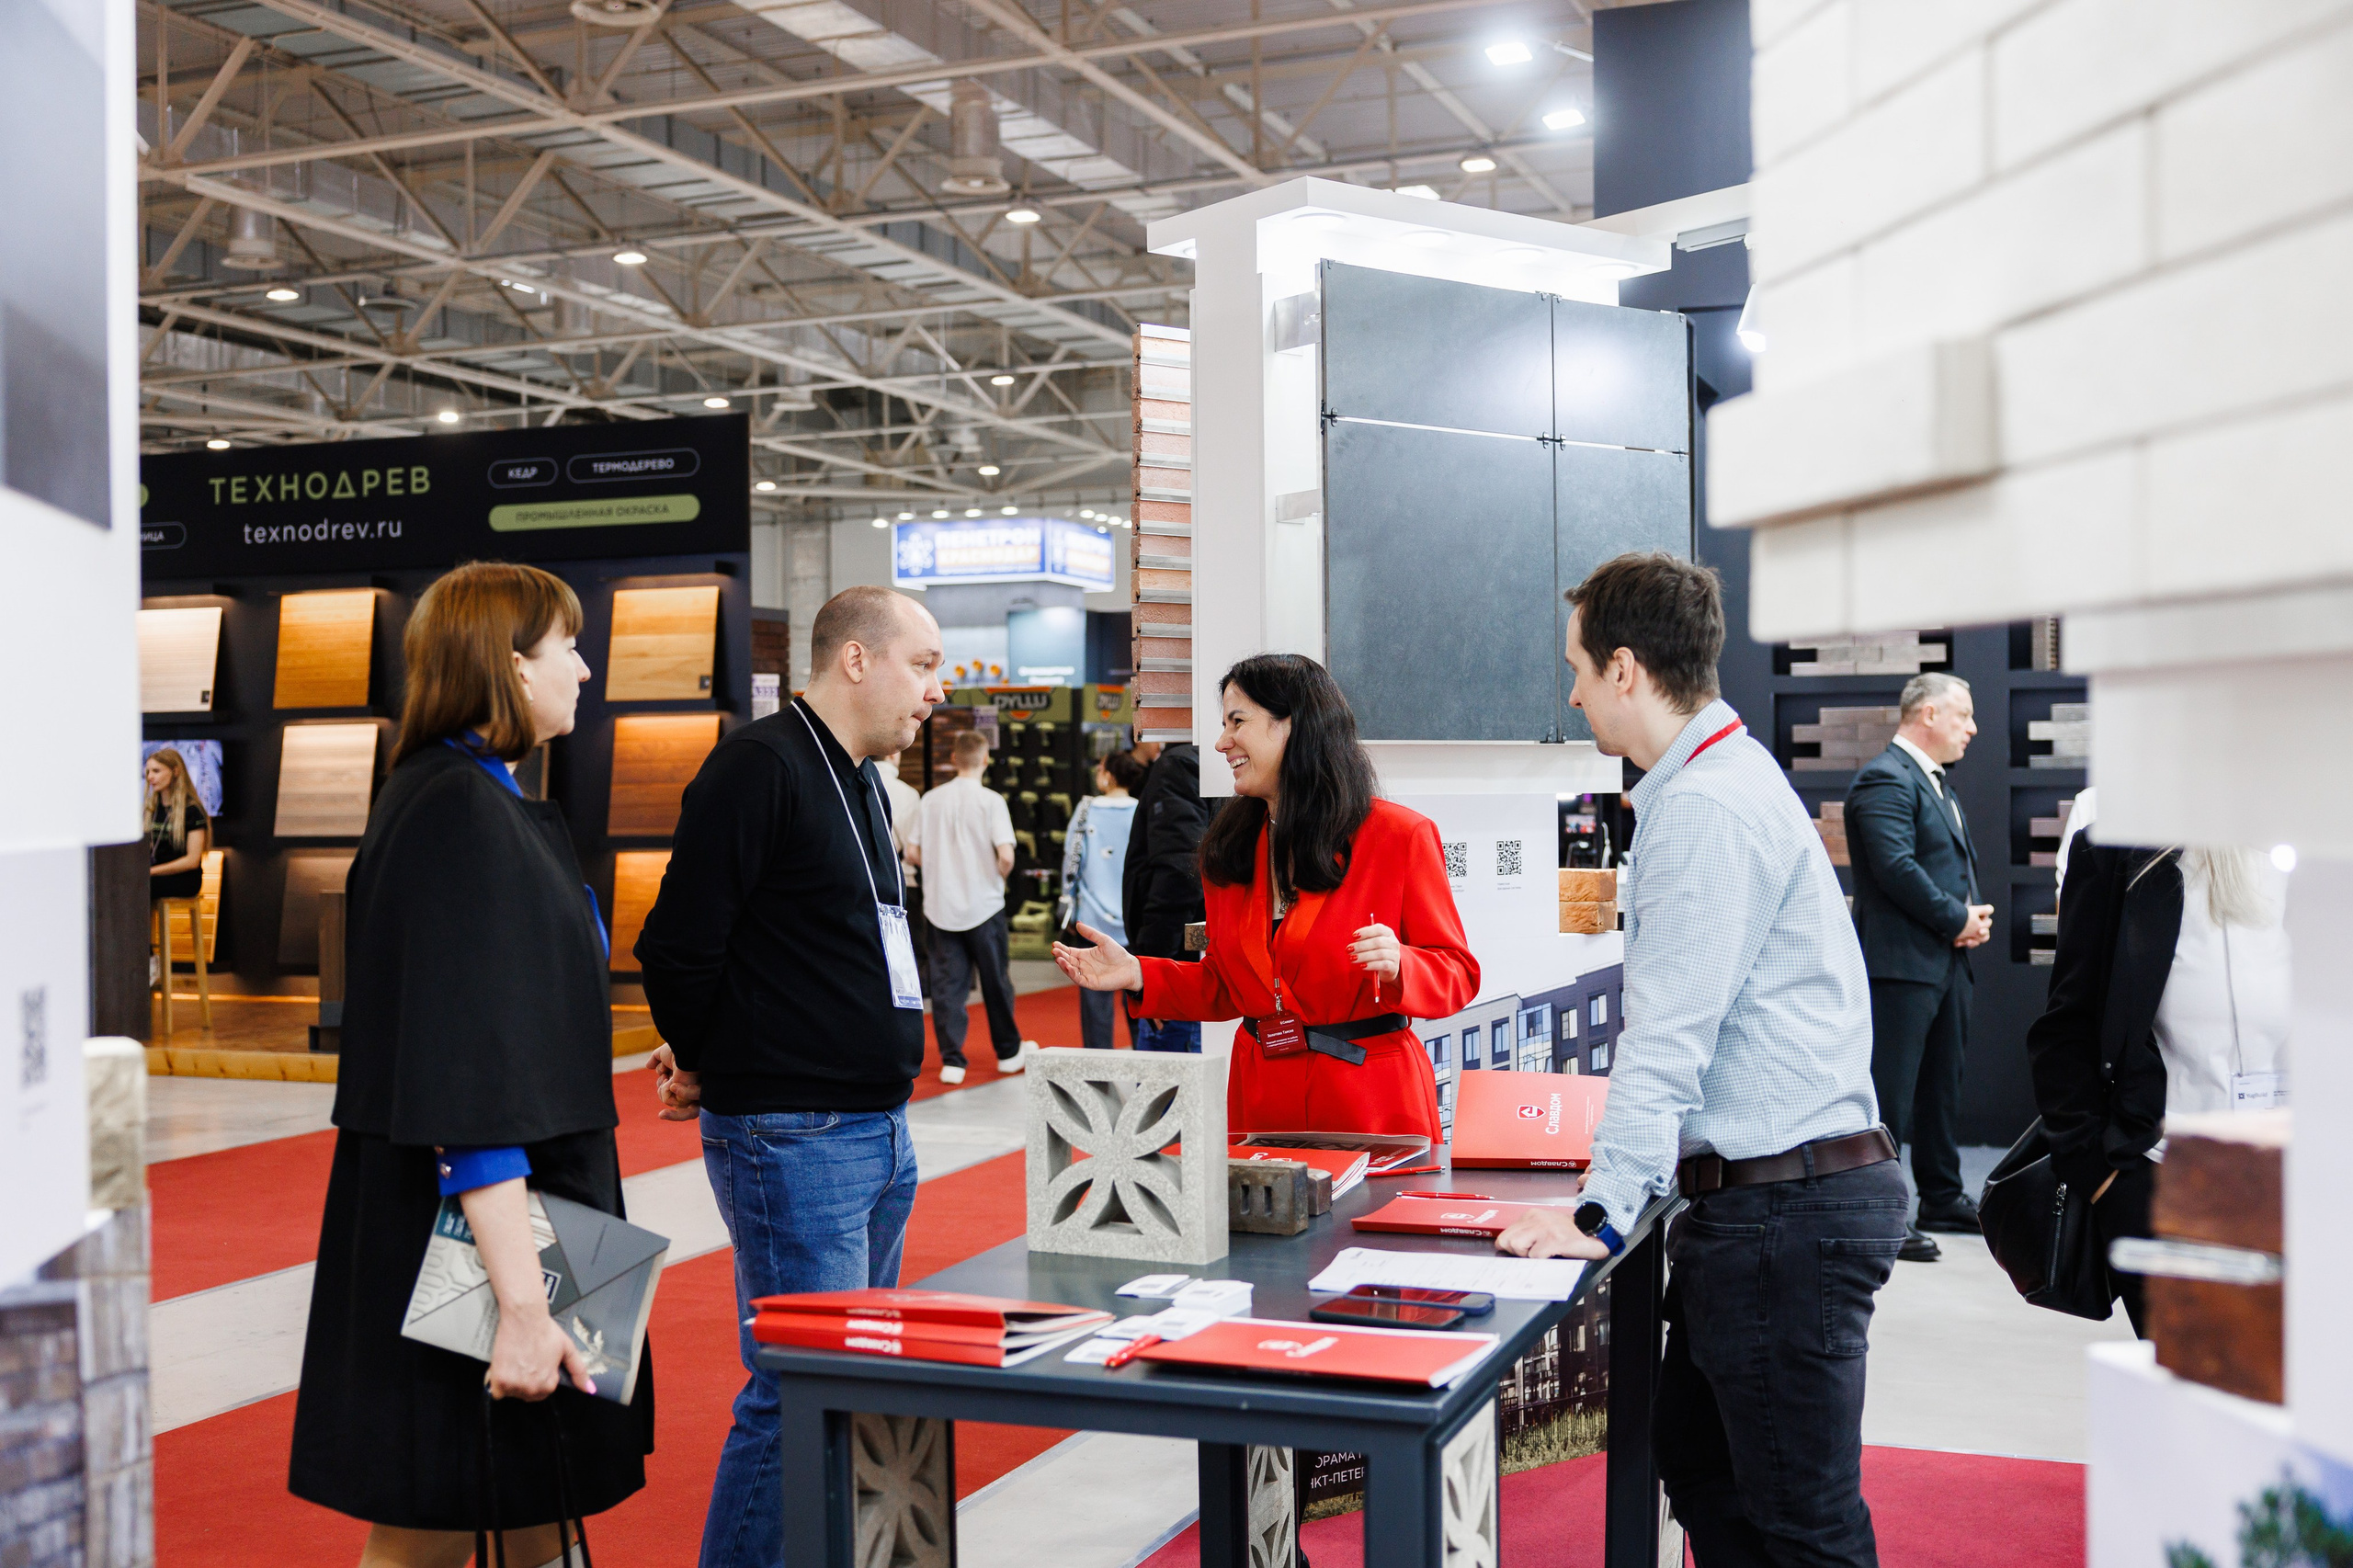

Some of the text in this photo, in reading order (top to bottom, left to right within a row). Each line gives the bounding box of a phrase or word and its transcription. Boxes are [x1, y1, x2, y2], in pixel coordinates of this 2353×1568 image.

[507, 466, 539, 480] КЕДР
[592, 458, 675, 474] ТЕРМОДЕРЕВО
[615, 505, 670, 517] ОКРАСКА
[244, 517, 403, 544] texnodrev.ru
[1545, 1093, 1563, 1135] Славдом
[1439, 1228, 1483, 1236] Славдом
